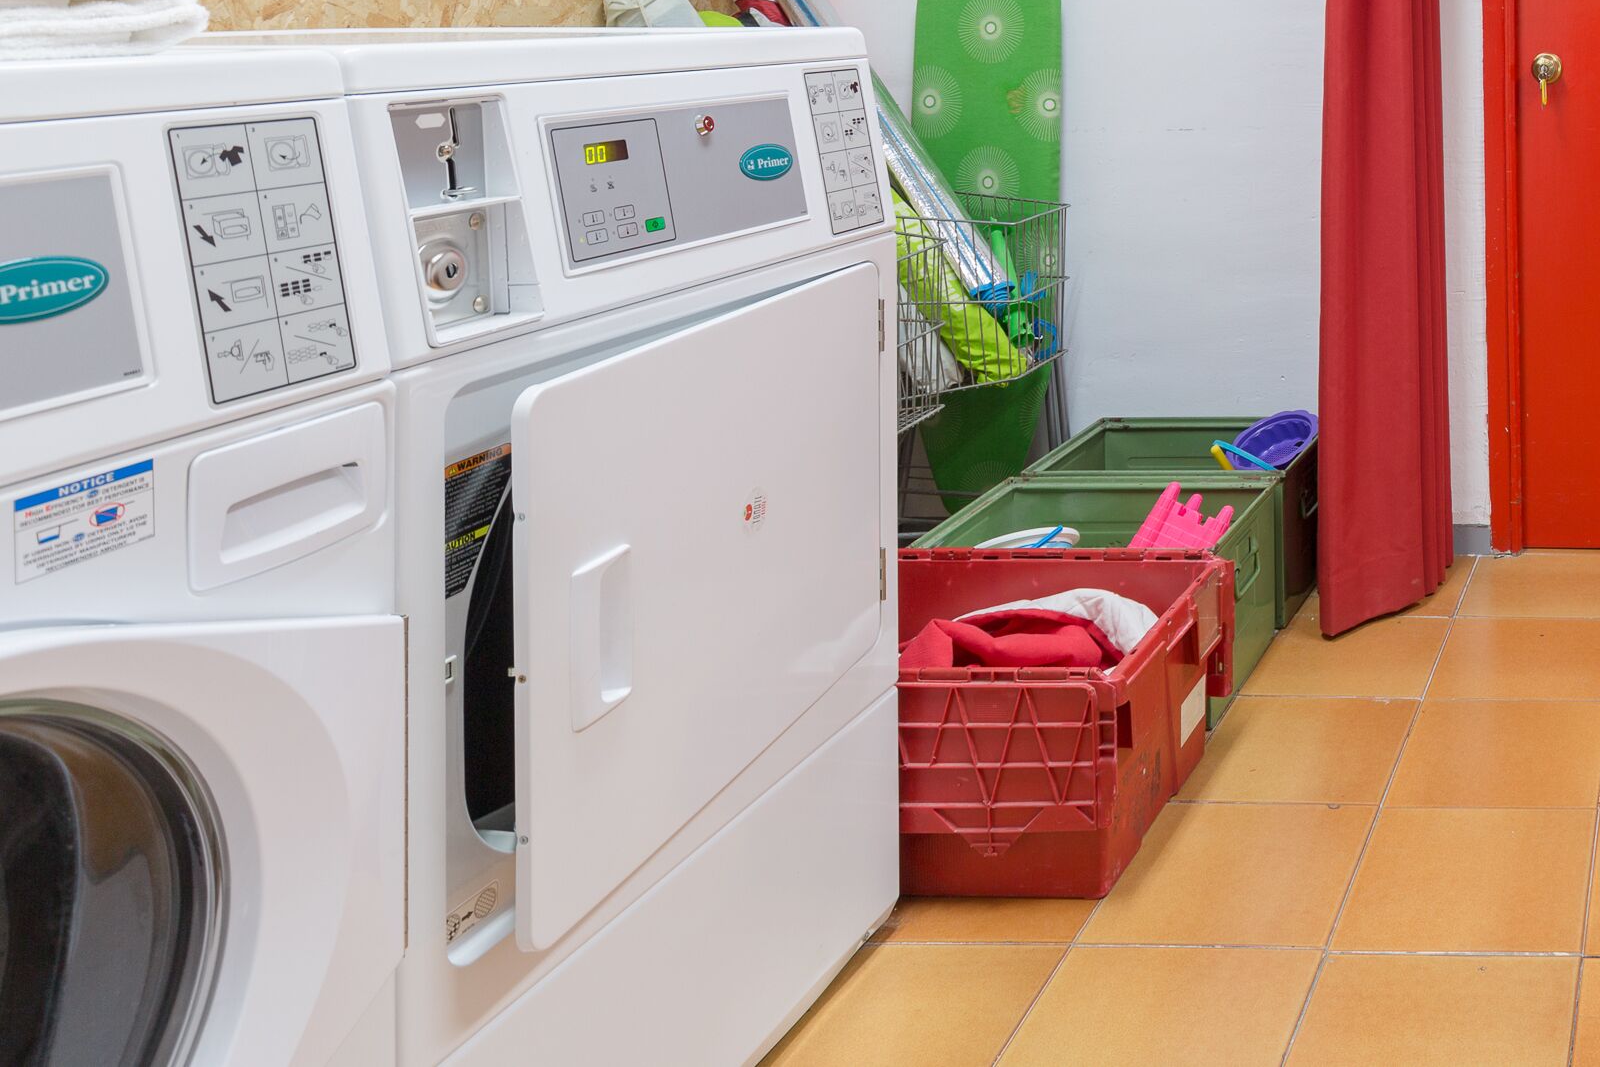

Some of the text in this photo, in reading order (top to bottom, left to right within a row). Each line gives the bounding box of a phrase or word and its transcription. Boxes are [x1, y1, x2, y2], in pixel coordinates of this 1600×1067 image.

[585, 145, 606, 165] 00
[757, 156, 789, 169] Primer
[0, 275, 96, 305] Primer
[457, 445, 503, 471] WARNING
[58, 472, 115, 497] NOTICE
[445, 531, 476, 552] AUTION
